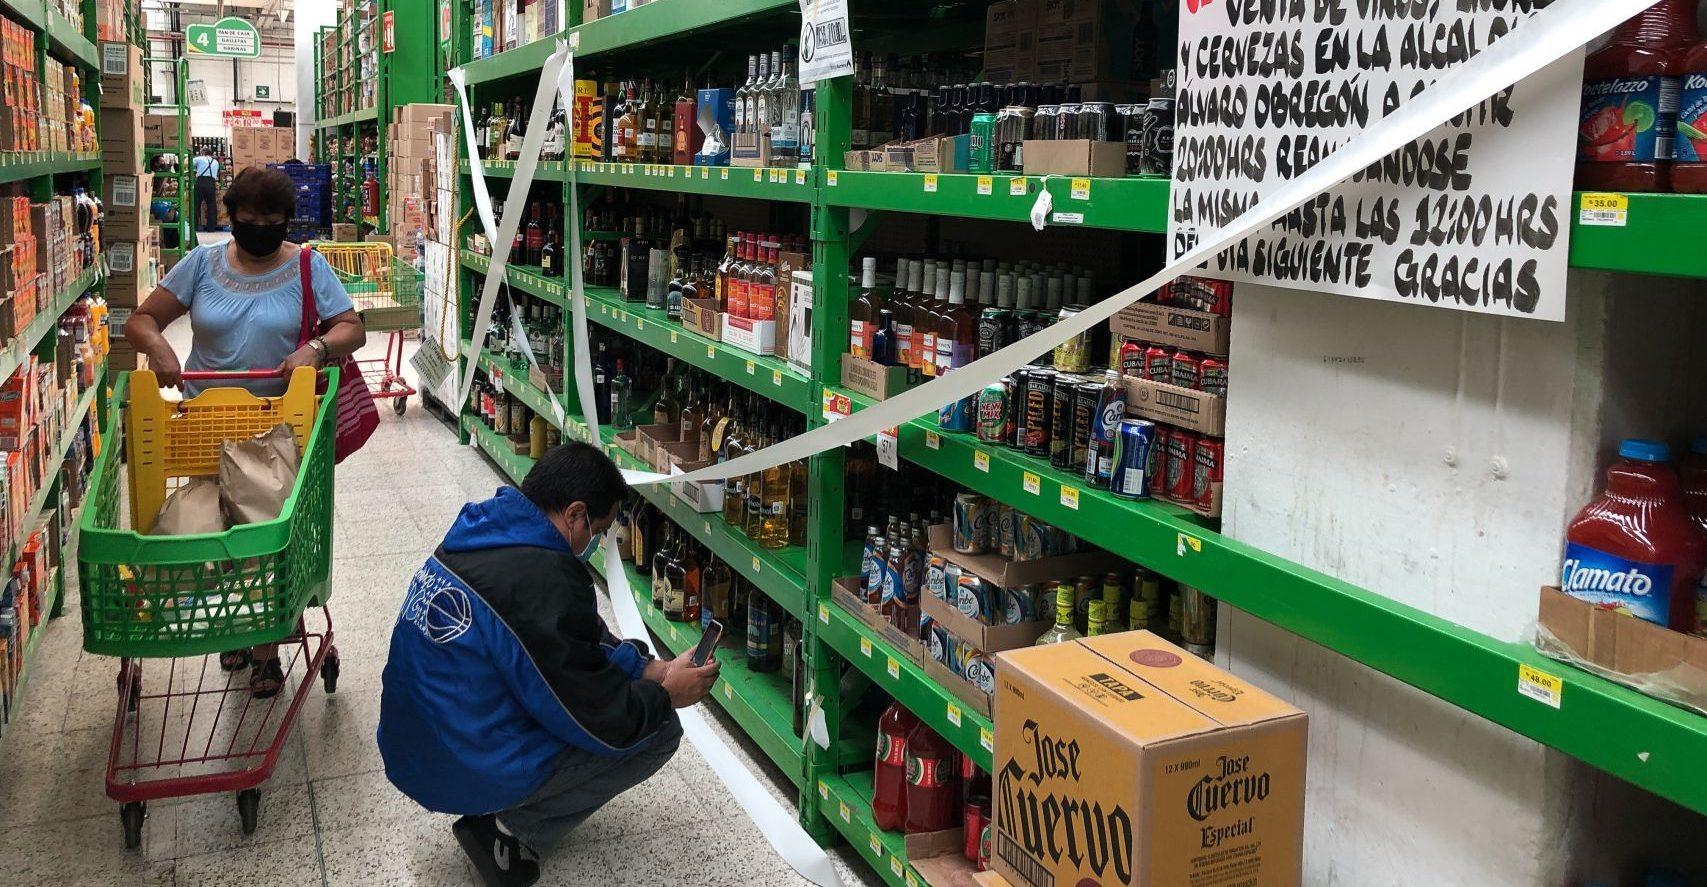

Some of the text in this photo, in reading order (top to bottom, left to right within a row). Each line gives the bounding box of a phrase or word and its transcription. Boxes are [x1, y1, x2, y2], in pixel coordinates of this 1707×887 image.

[197, 33, 209, 46] 4
[1181, 40, 1191, 83] Y
[1197, 28, 1305, 80] CERVEZAS
[1315, 27, 1350, 74] EN
[1357, 24, 1391, 72] LA
[1177, 78, 1248, 129] ÁLVARO
[1255, 72, 1369, 129] OBREGÓN
[1174, 188, 1193, 223] LA
[1356, 196, 1401, 246] LAS
[1253, 236, 1374, 289] SIGUIENTE
[1394, 248, 1541, 314] GRACIAS
[1562, 558, 1653, 597] Clamato
[1022, 718, 1082, 787] Jose
[1165, 763, 1173, 774] 12
[1174, 762, 1179, 772] X
[1216, 755, 1250, 782] Jose
[998, 757, 1133, 886] Cuervo
[1187, 772, 1271, 821] Cuervo
[1201, 816, 1254, 849] Especial
